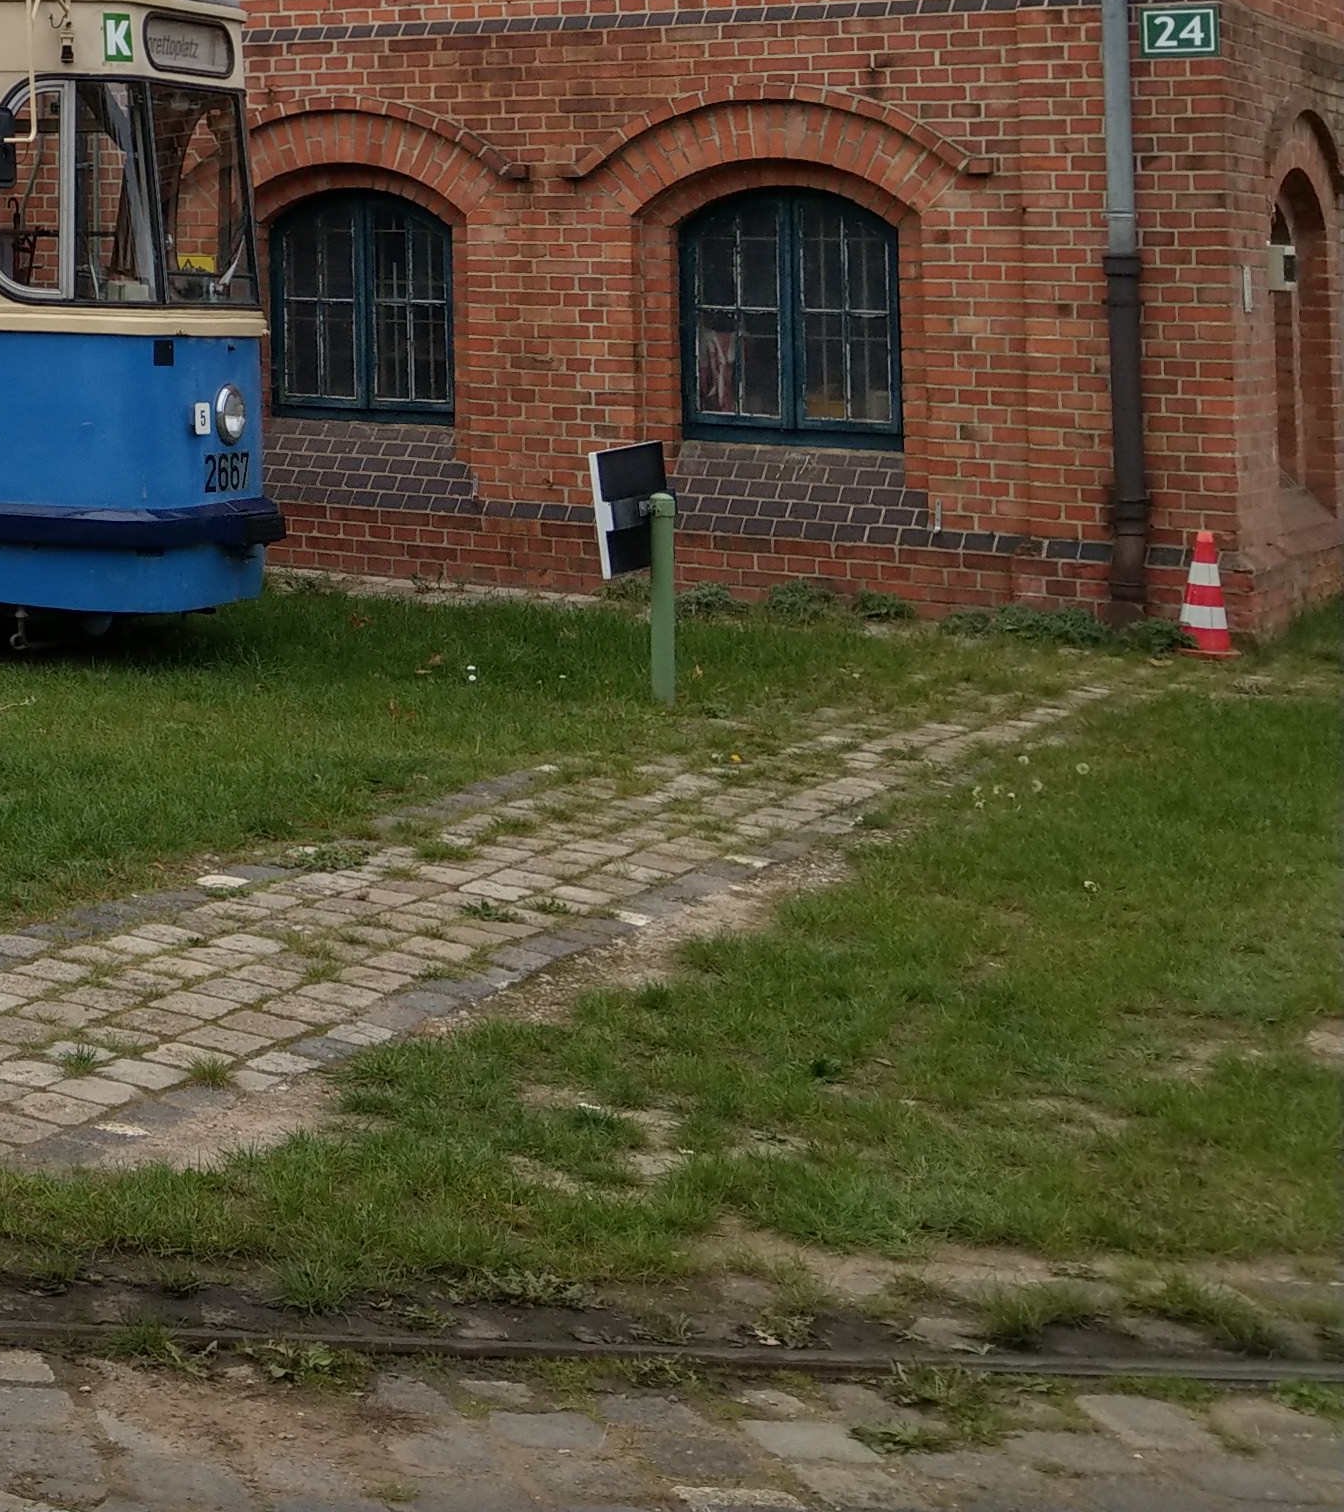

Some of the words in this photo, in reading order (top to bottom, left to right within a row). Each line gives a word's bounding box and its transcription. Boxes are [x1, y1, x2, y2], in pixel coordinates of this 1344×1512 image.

[105, 19, 132, 56] K
[1153, 15, 1205, 47] 24
[200, 410, 206, 427] 5
[205, 452, 249, 493] 2667
